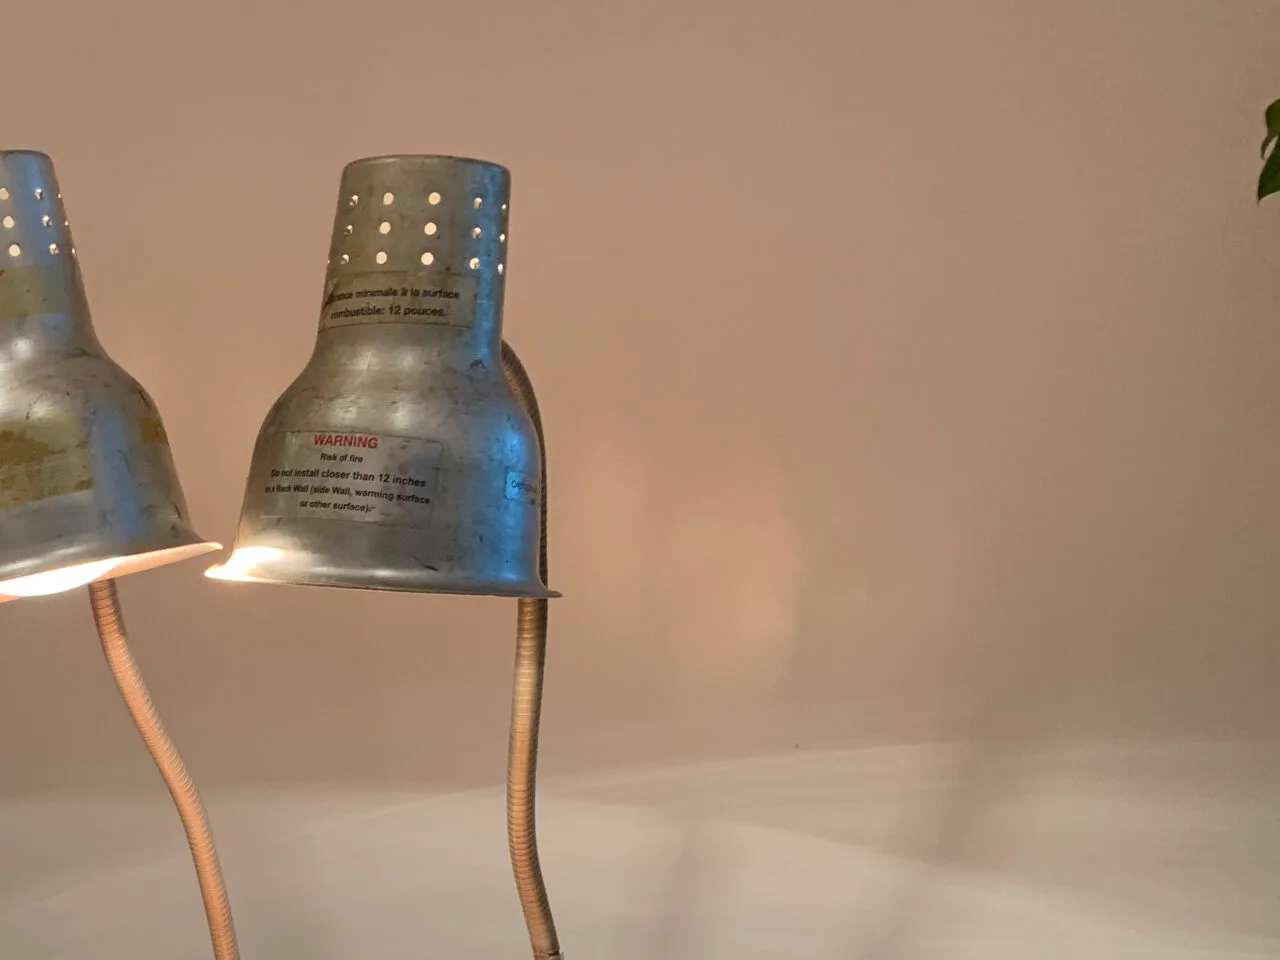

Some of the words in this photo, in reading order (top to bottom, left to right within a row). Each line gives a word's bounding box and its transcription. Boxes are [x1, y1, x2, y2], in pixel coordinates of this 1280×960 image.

[422, 289, 460, 300] surface
[389, 305, 401, 315] 12
[314, 434, 379, 449] WARNING
[320, 453, 337, 462] Risk
[339, 454, 348, 462] of
[349, 454, 363, 464] fire
[321, 469, 350, 480] closer
[352, 471, 375, 482] than
[378, 473, 390, 482] 12
[392, 475, 426, 487] inches
[310, 485, 330, 495] (side
[355, 489, 394, 501] warming
[396, 493, 431, 505] surface
[309, 500, 331, 509] other
